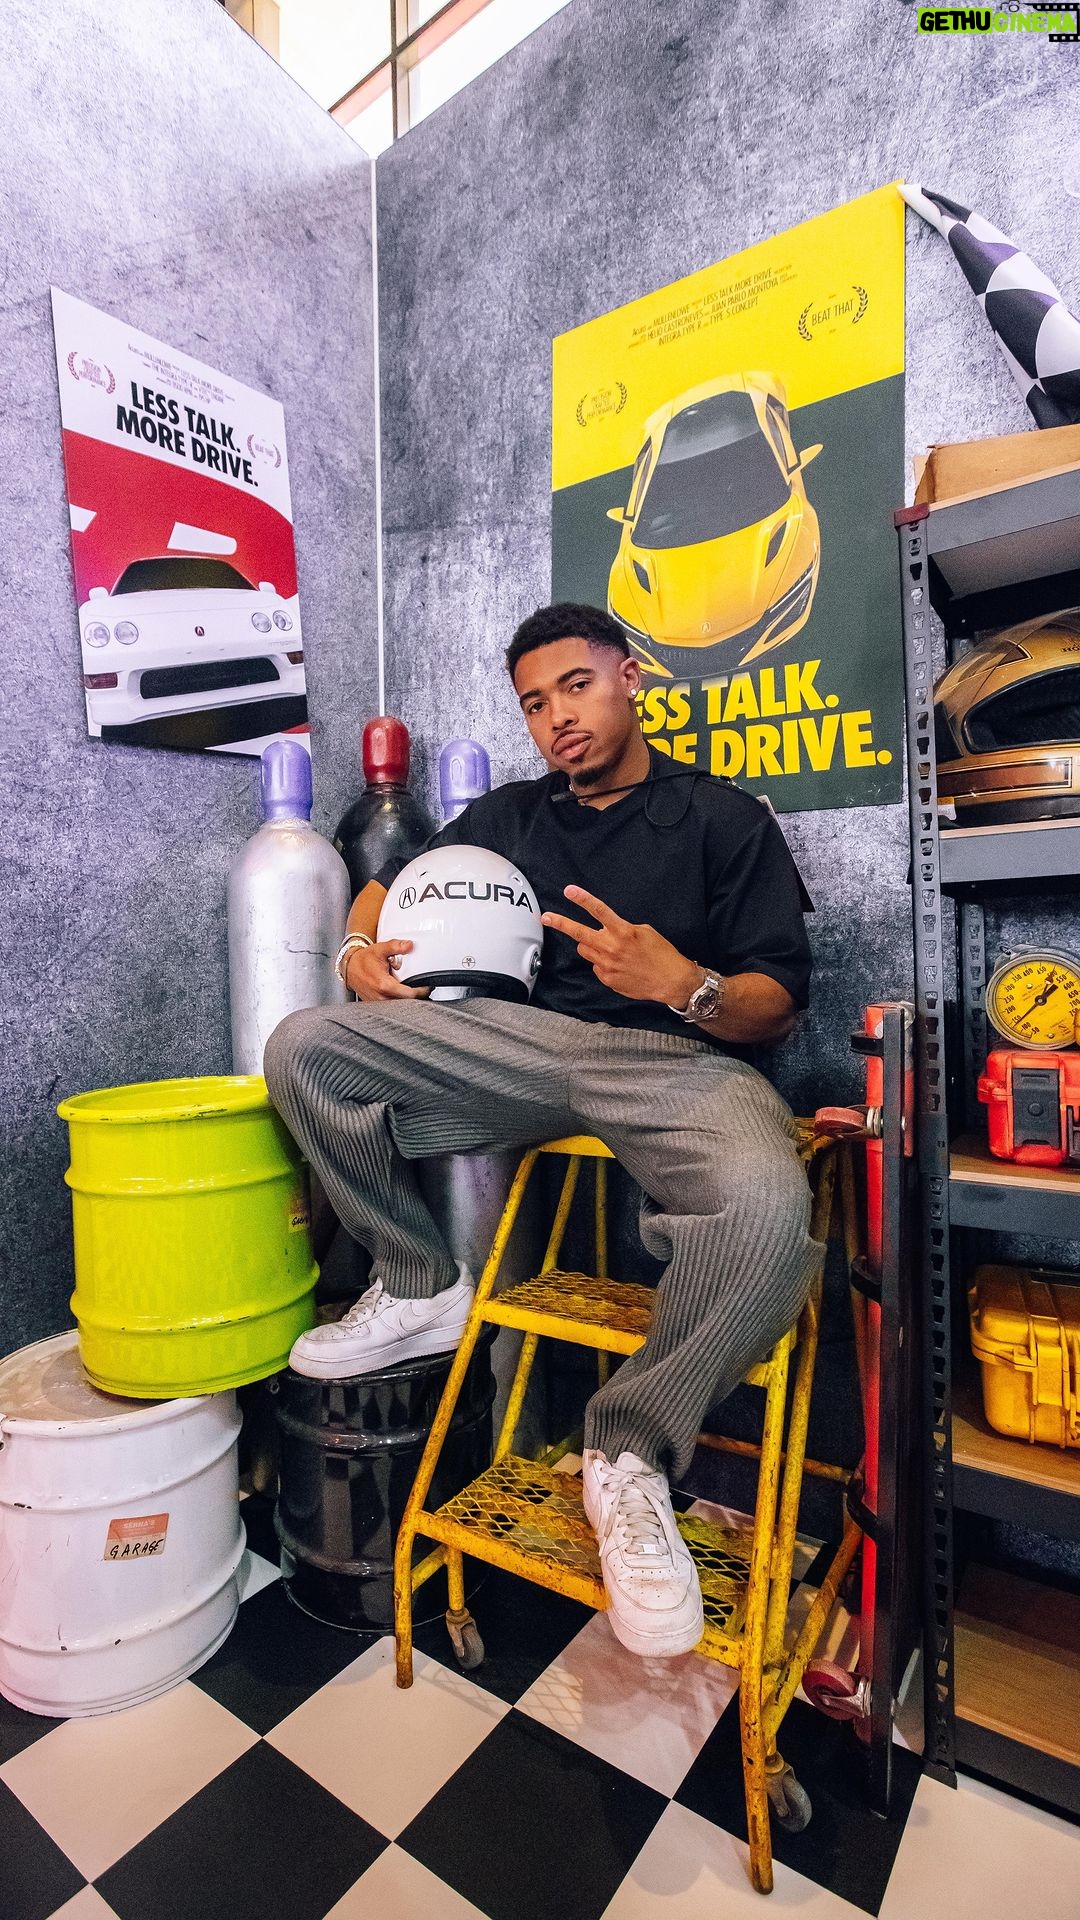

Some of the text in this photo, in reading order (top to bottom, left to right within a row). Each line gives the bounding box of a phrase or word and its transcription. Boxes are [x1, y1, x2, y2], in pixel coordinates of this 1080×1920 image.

[704, 291, 719, 306] LESS
[720, 284, 734, 298] TALK
[734, 275, 752, 292] MORE
[754, 267, 772, 284] DRIVE
[711, 300, 726, 314] JUAN
[727, 290, 747, 307] PABLO
[747, 277, 778, 299] MONTOYA
[812, 298, 854, 326] BEAT THAT
[658, 330, 681, 346] INTEGRA
[682, 323, 695, 337] TYPE
[710, 311, 724, 325] TYPE
[731, 296, 759, 316] CONCEPT
[131, 381, 180, 425] LESS
[183, 405, 241, 454] TALK.
[116, 404, 259, 487] MORE DRIVE.
[701, 659, 840, 725] TALK.
[710, 710, 893, 778] DRIVE.
[418, 881, 534, 913] ACURA
[1022, 967, 1034, 977] 400
[1036, 966, 1047, 975] 450
[1012, 974, 1022, 983] 350
[1056, 974, 1068, 984] 550
[1004, 983, 1016, 992] 300
[1064, 980, 1075, 990] 600
[1068, 989, 1079, 998] 650
[1004, 994, 1015, 1004] 250
[1005, 1005, 1016, 1014] 200
[1021, 1022, 1032, 1031] 100
[1032, 1026, 1040, 1034] 50
[110, 1538, 164, 1559] GARAGE
